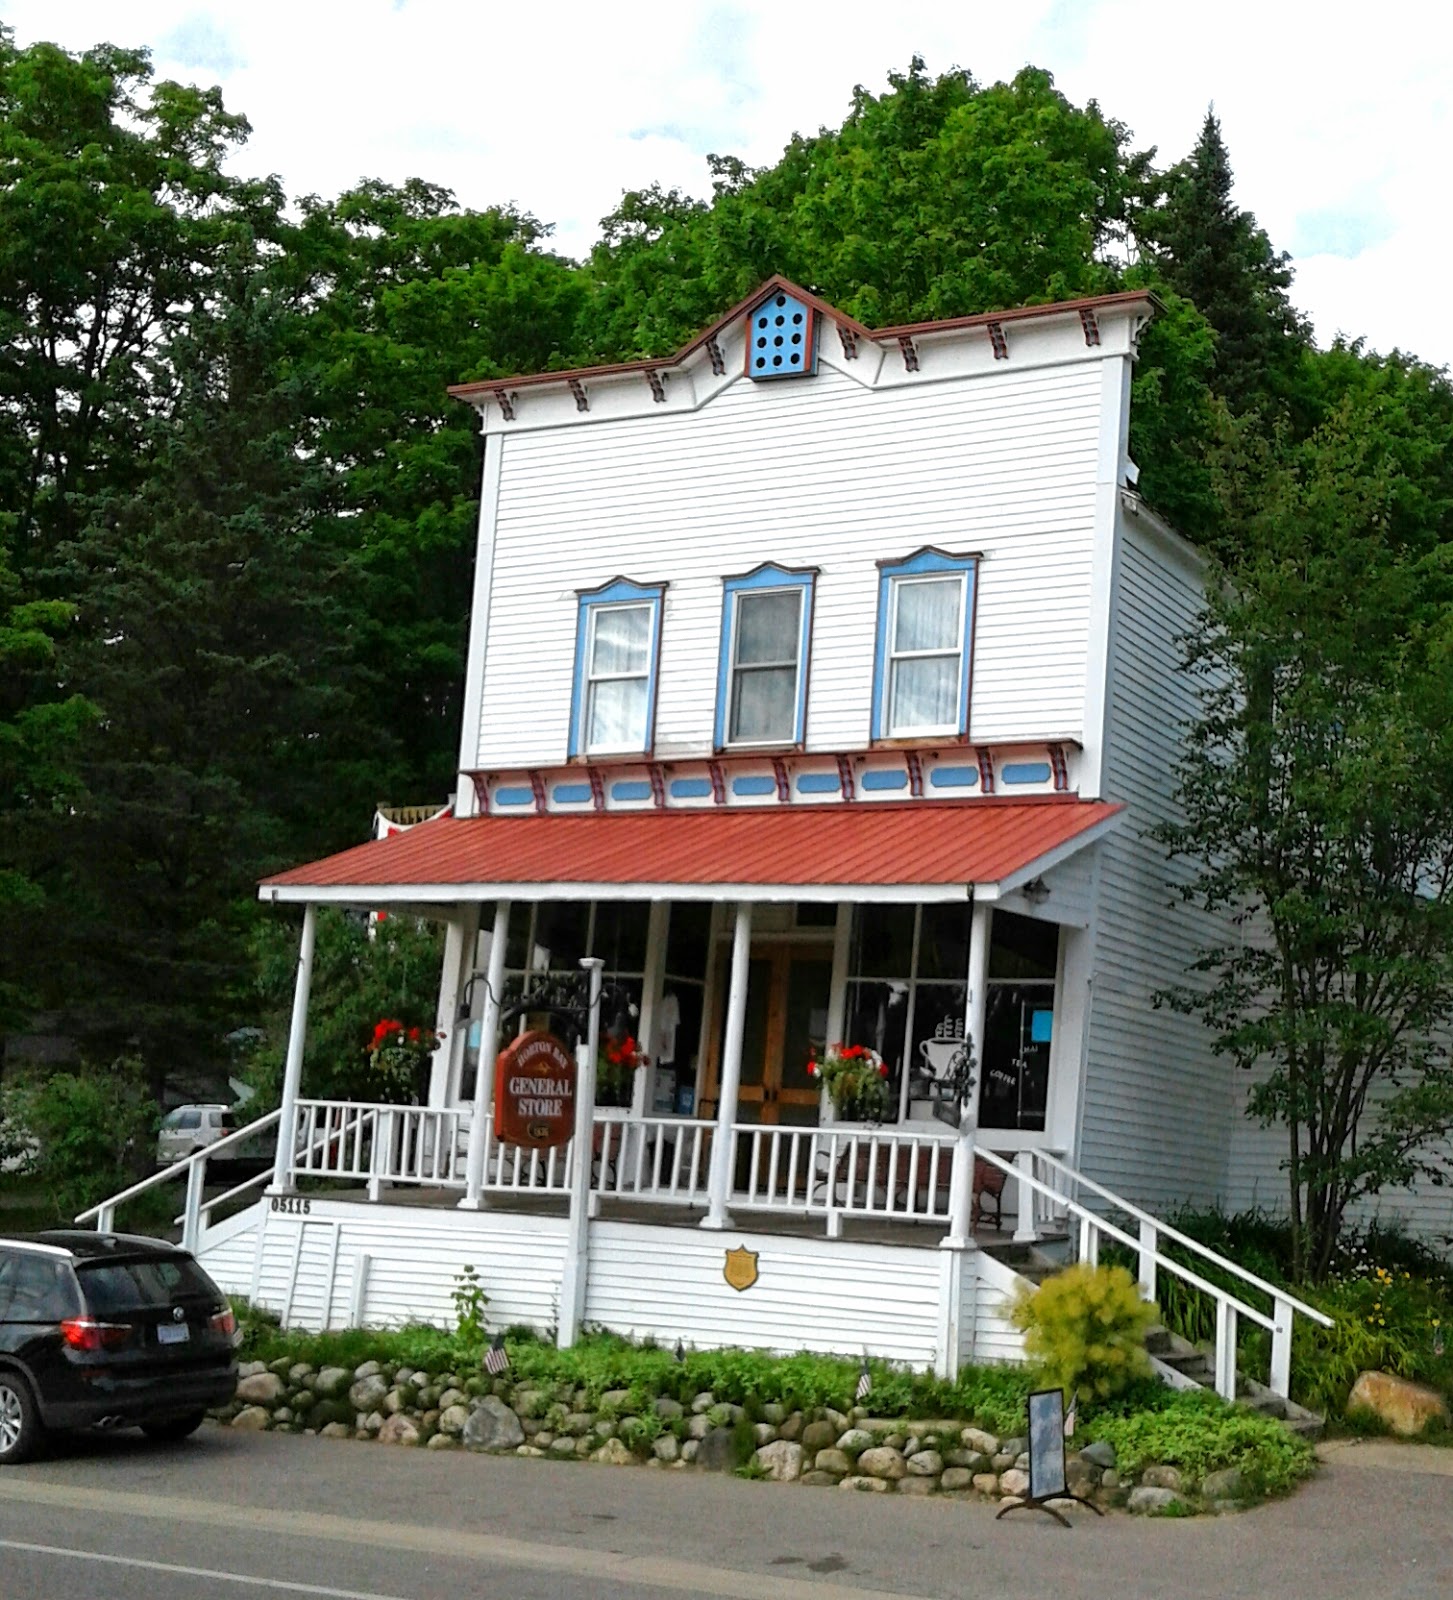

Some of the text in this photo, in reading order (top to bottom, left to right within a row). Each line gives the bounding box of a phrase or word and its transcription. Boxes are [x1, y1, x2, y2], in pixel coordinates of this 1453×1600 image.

[509, 1077, 573, 1096] GENERAL
[518, 1098, 563, 1117] STORE
[271, 1197, 311, 1215] 05115
